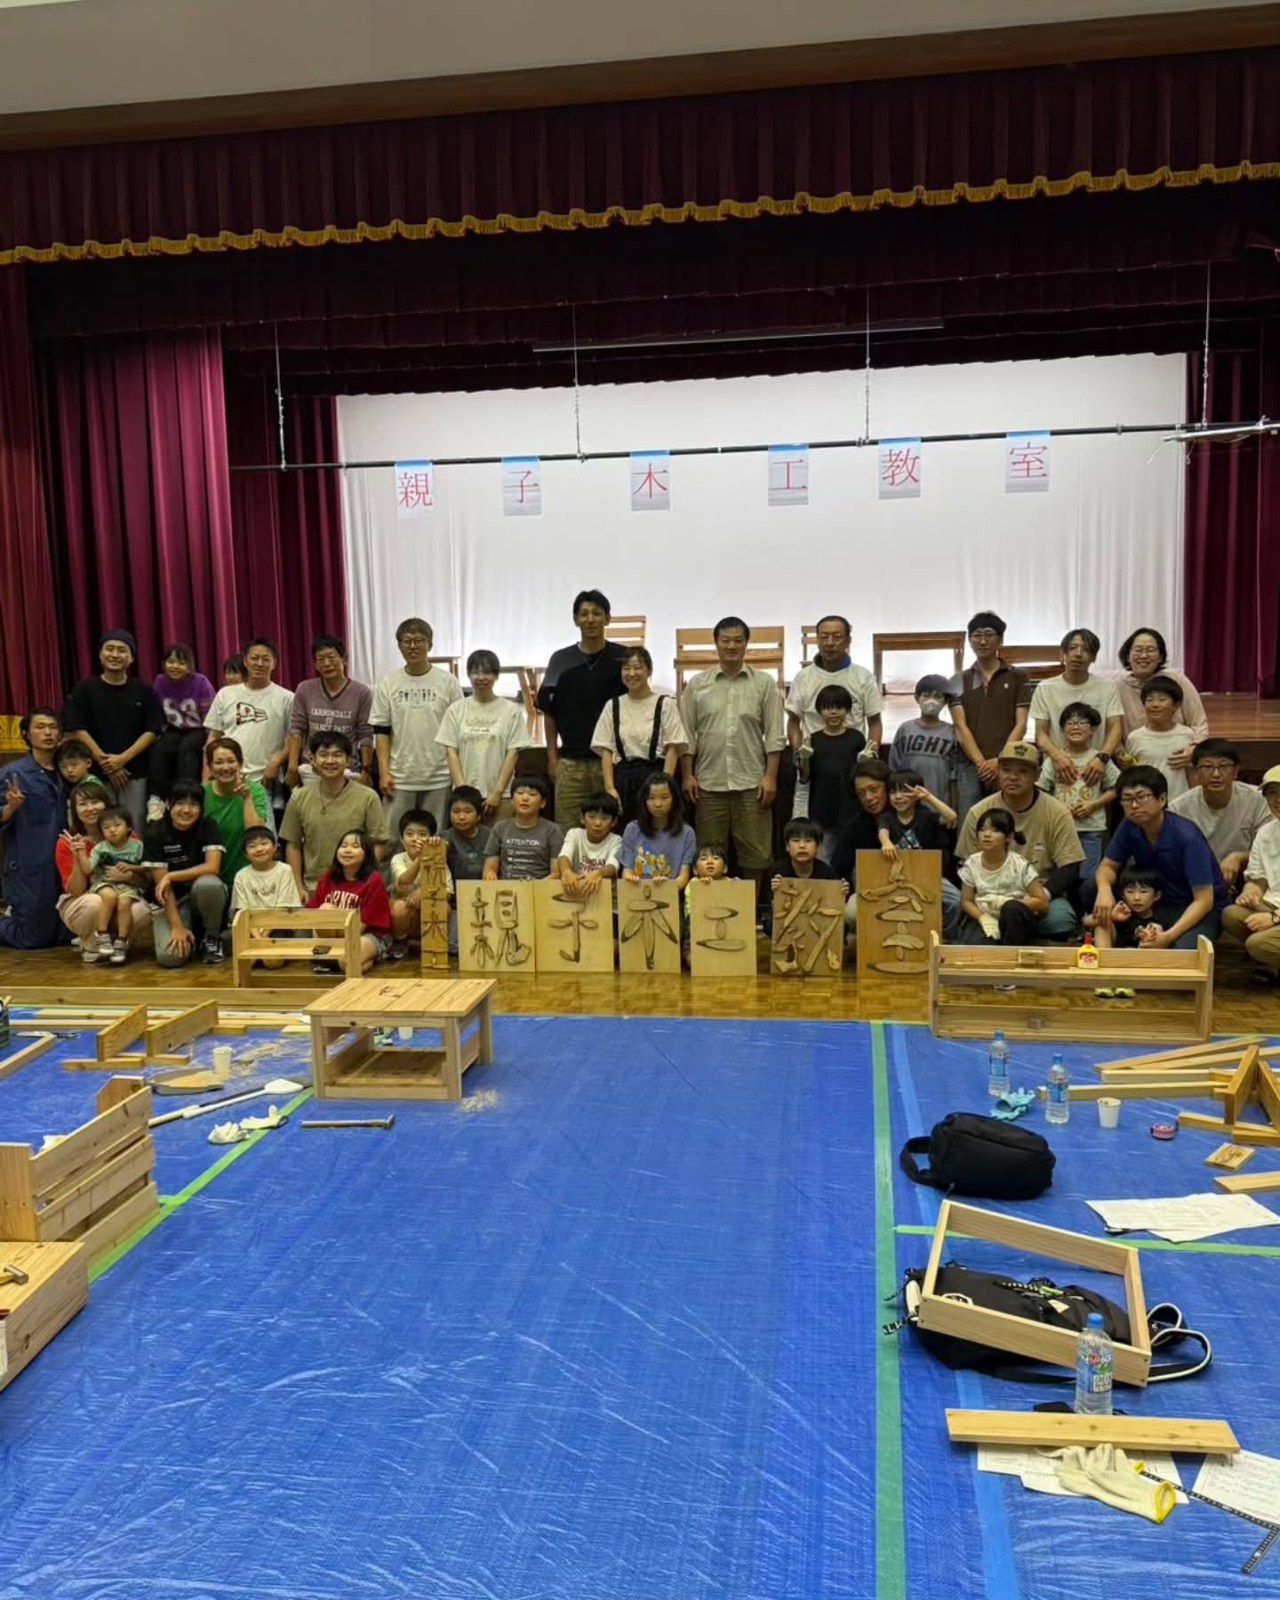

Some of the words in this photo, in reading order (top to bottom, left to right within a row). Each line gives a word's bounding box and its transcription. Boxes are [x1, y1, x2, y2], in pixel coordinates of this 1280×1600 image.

[398, 472, 433, 508] 親
[504, 470, 539, 503] 子
[633, 463, 668, 498] 木
[768, 459, 807, 490] 工
[881, 448, 920, 487] 教
[1010, 442, 1048, 480] 室
